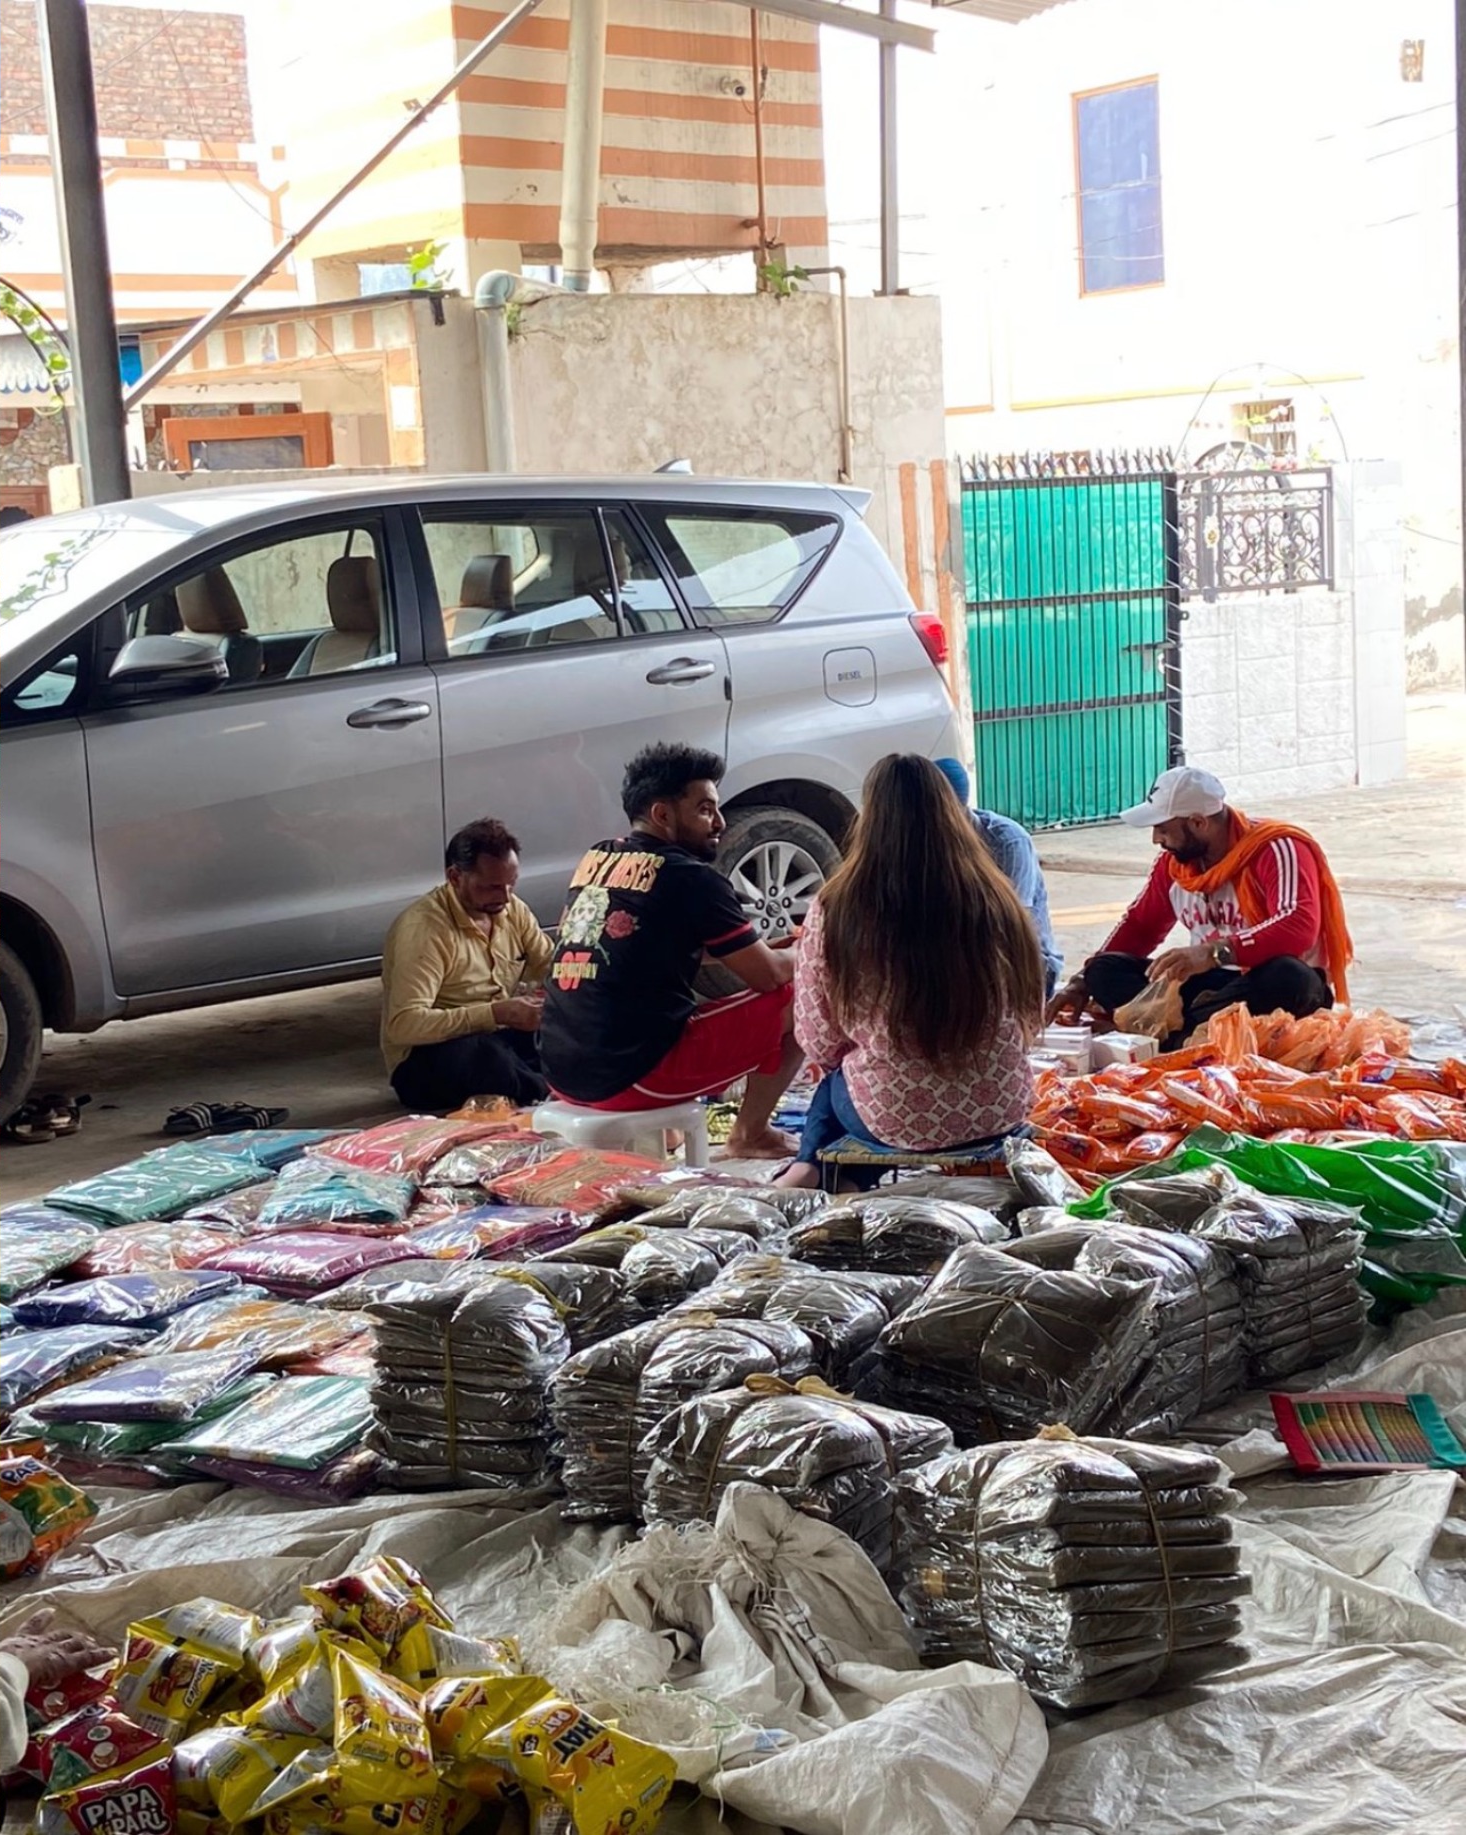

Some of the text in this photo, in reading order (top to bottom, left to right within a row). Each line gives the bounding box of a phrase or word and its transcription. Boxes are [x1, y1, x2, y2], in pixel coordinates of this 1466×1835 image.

[604, 851, 665, 892] ROSES
[543, 1707, 574, 1736] PAT
[85, 1786, 156, 1824] PAPA
